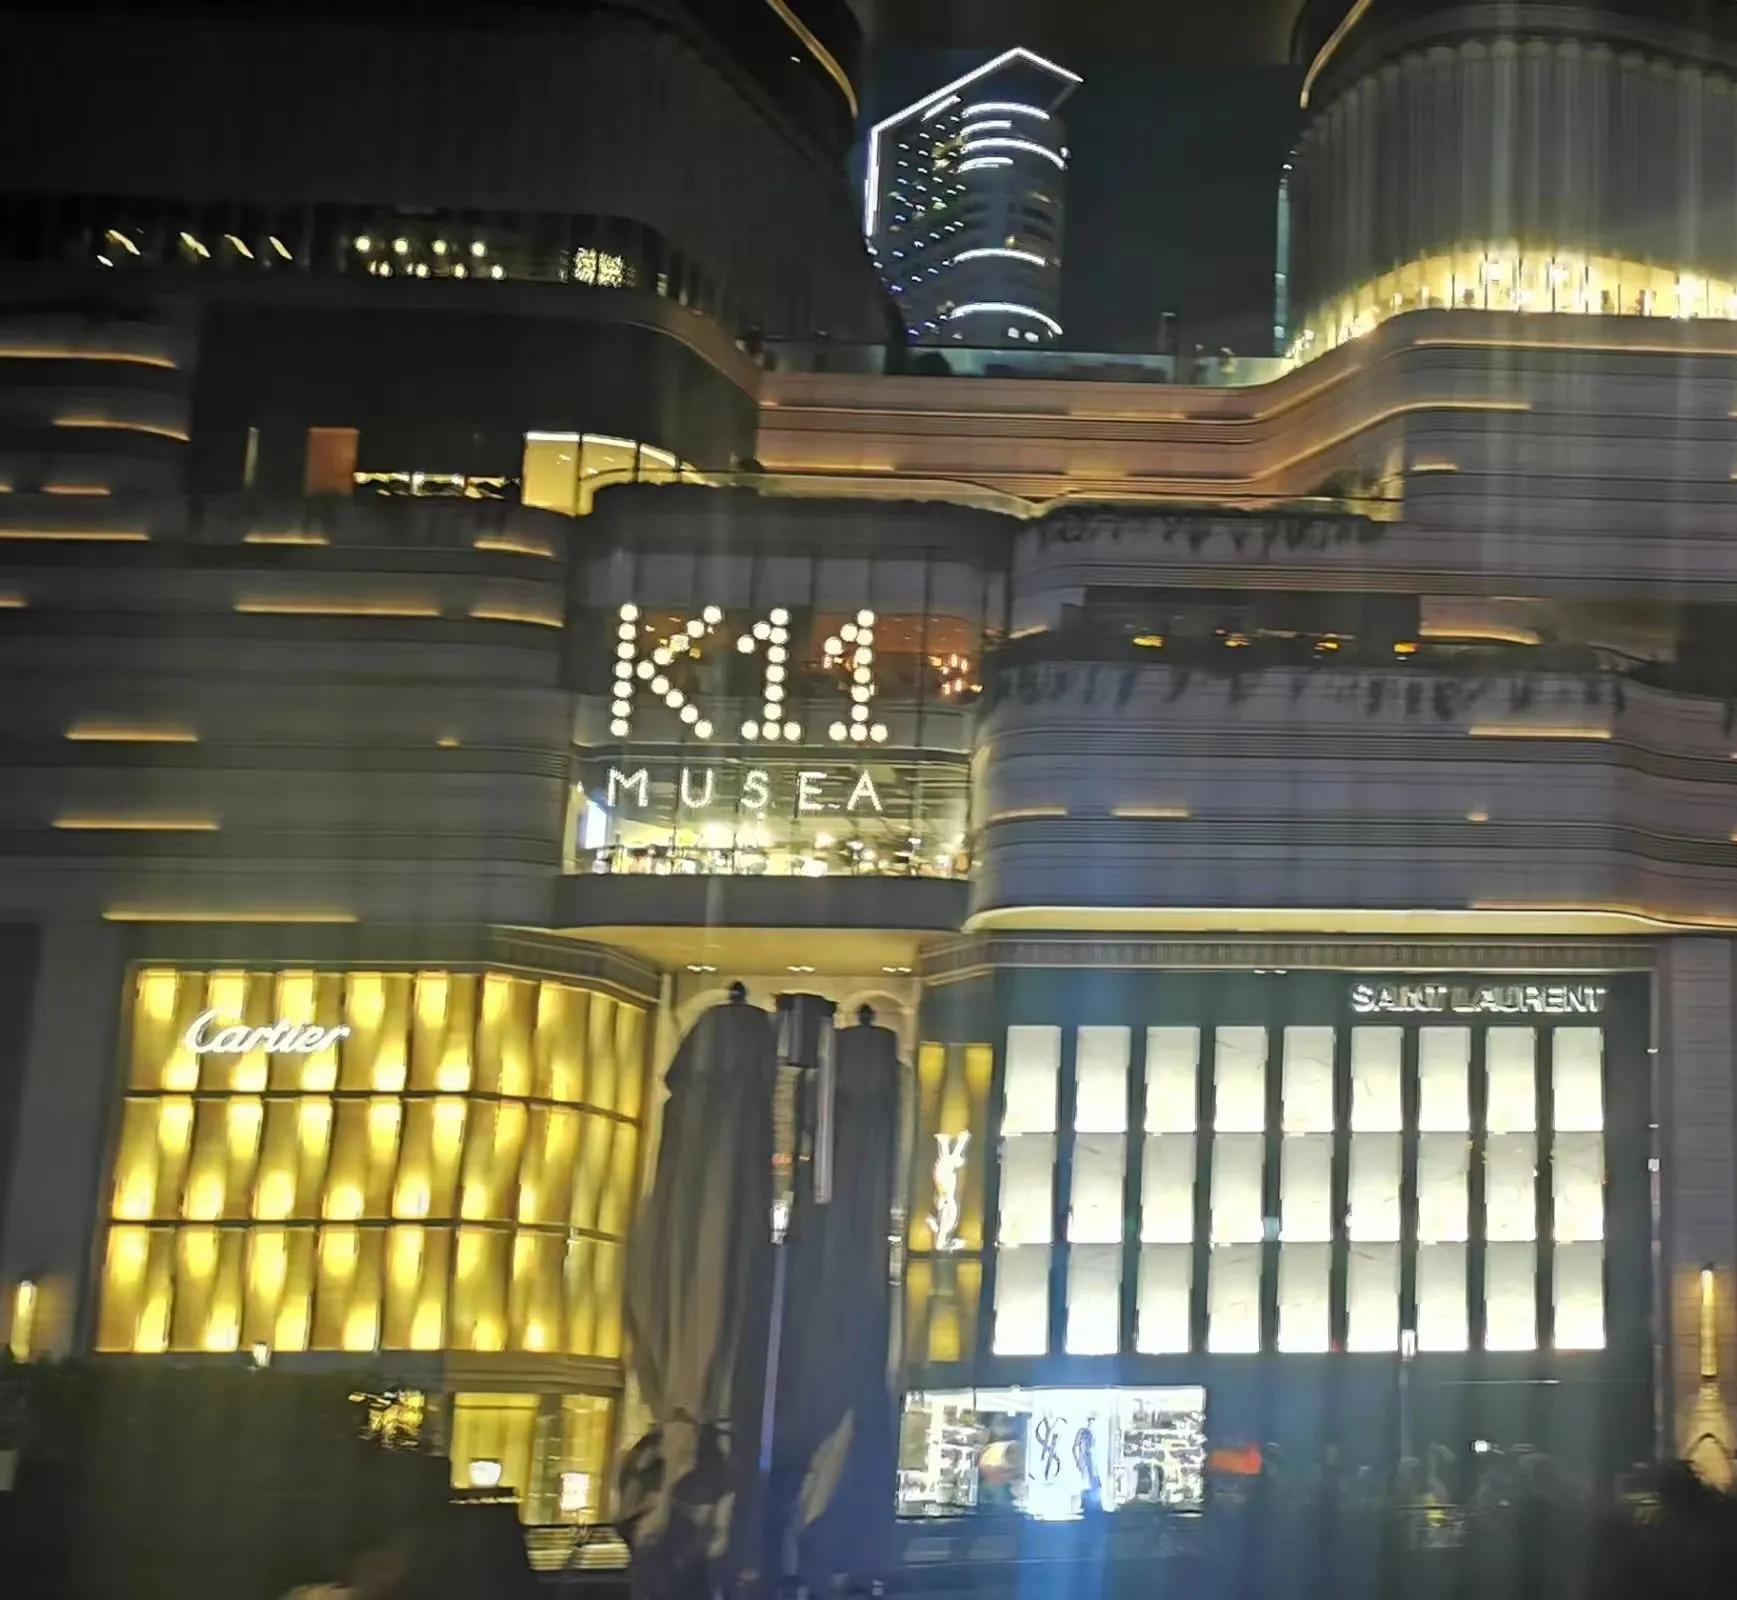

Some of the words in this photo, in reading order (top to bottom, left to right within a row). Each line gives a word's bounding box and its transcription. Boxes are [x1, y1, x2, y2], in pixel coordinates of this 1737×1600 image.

[609, 602, 890, 744] K11
[606, 766, 883, 813] MUSEA
[1351, 983, 1447, 1012] SAINT
[1451, 983, 1608, 1013] LAURENT
[184, 1008, 351, 1053] Cartier
